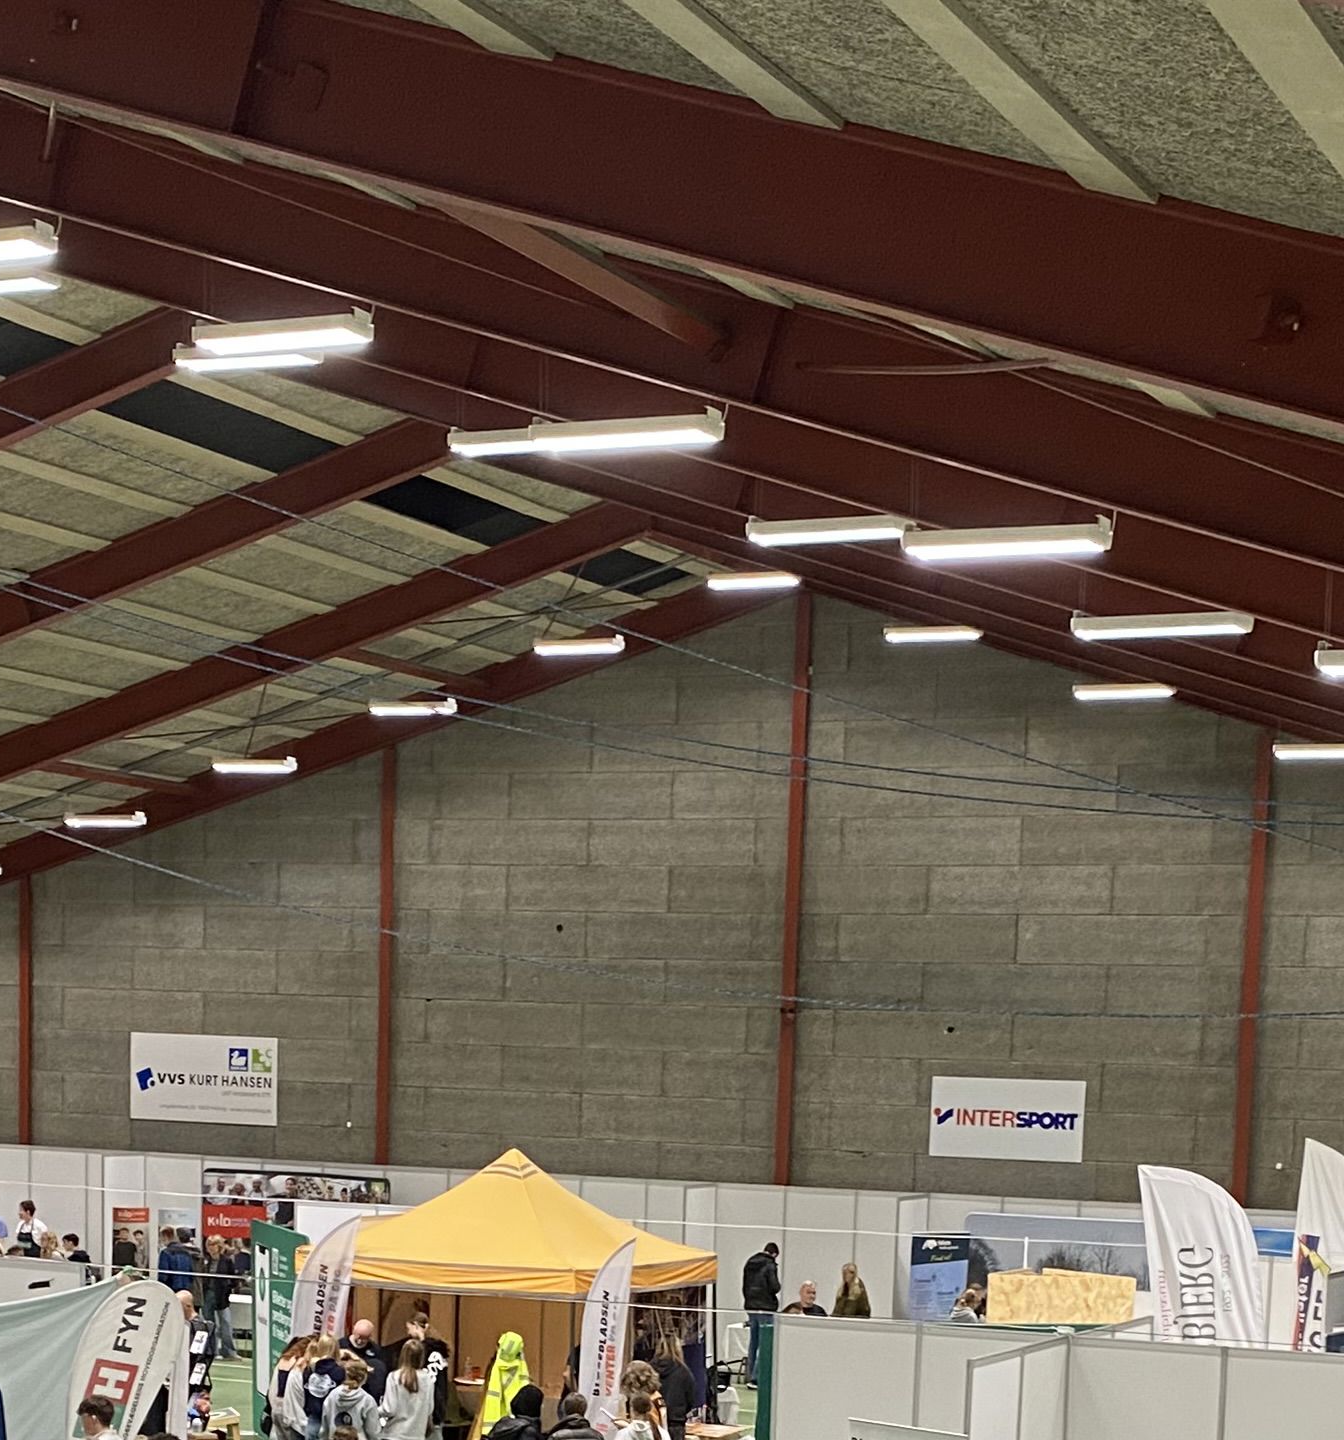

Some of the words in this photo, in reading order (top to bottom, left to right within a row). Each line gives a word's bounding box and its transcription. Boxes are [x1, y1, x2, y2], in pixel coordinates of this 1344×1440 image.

[157, 1072, 185, 1085] VVS
[189, 1074, 218, 1086] KURT
[221, 1076, 272, 1088] HANSEN
[957, 1108, 1078, 1130] INTERSPORT
[113, 1296, 147, 1353] FYN
